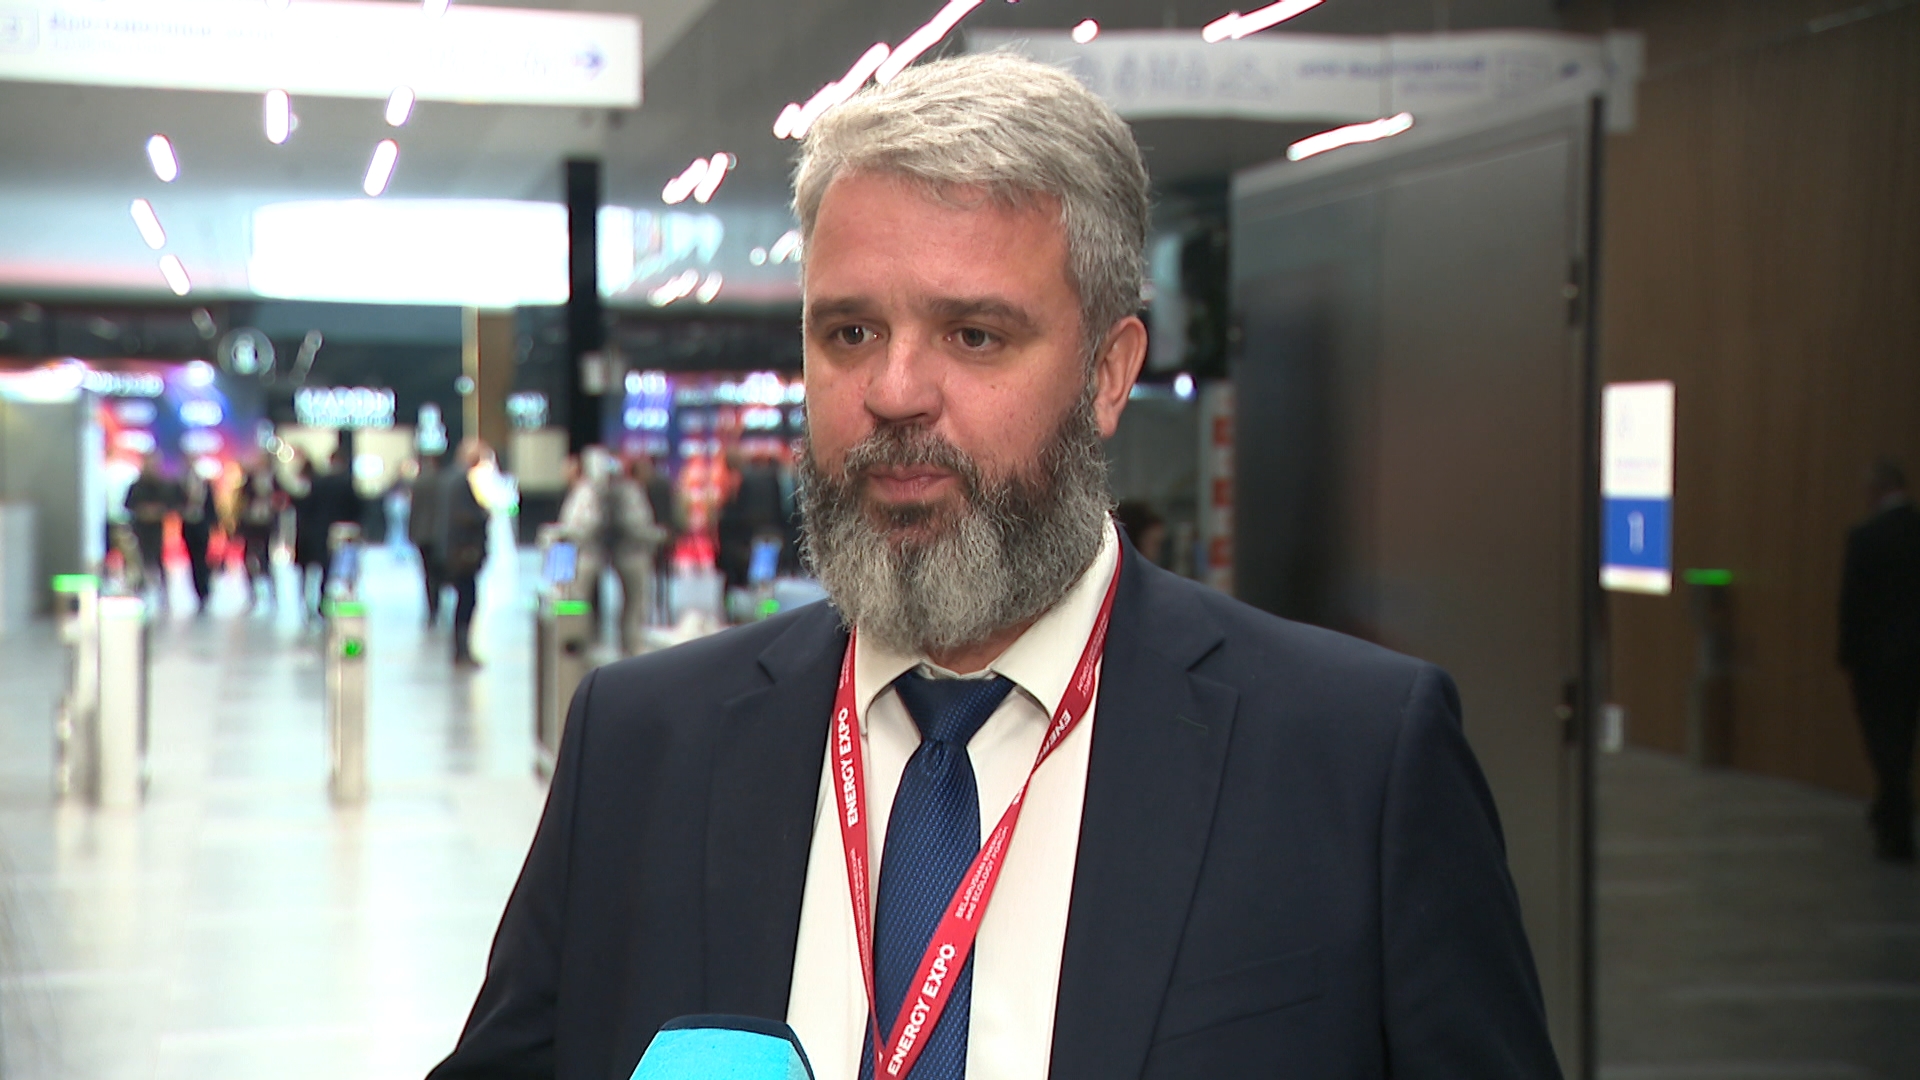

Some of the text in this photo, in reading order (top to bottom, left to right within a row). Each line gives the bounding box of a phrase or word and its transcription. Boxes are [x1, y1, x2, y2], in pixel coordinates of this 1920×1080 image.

[1627, 510, 1645, 555] 1
[838, 707, 852, 757] EXPO
[841, 758, 859, 828] ENERGY
[955, 862, 986, 918] BELARUSIAN
[965, 826, 1009, 921] and ECOLOGY FORUM
[887, 943, 956, 1077] ENERGY EXPO
